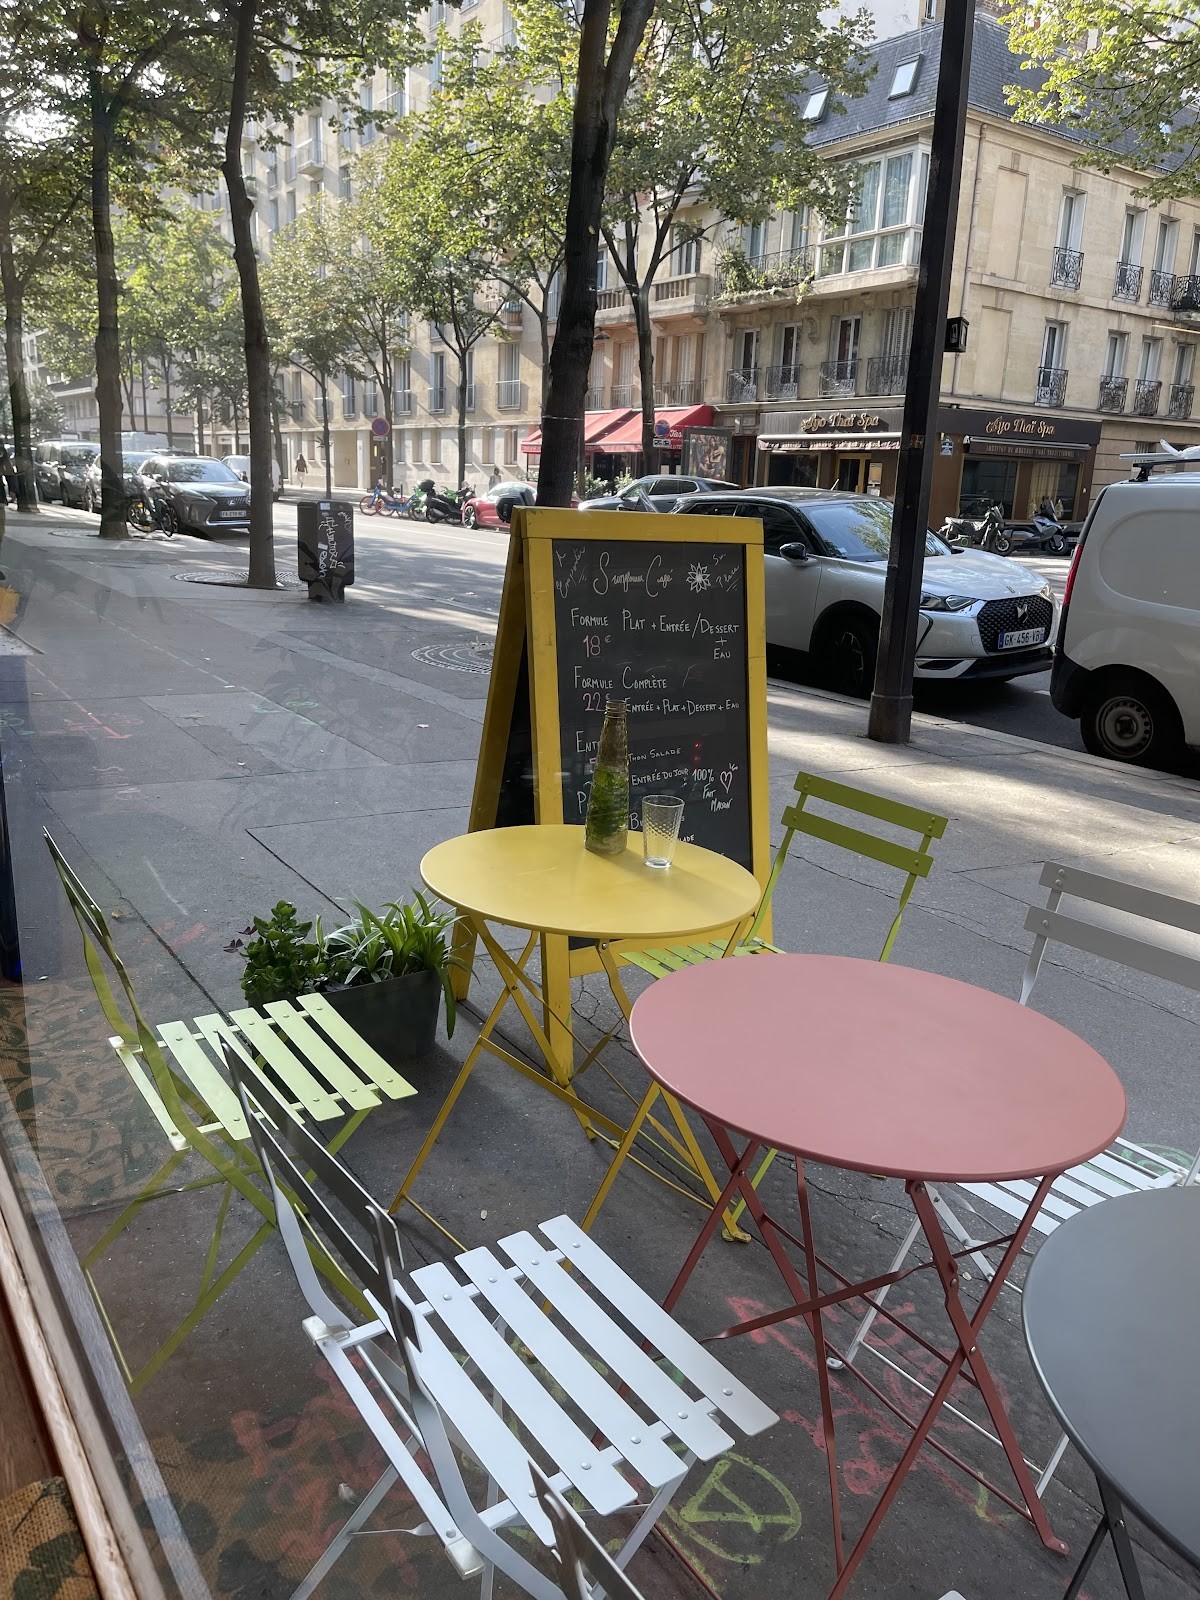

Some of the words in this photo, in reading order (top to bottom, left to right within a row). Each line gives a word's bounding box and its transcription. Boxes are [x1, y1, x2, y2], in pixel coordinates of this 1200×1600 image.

[801, 414, 826, 431] Ayo
[829, 412, 855, 428] Thaï
[857, 413, 880, 430] Spa
[986, 417, 1010, 435] Ayo
[1013, 417, 1035, 434] Thaï
[1037, 421, 1055, 438] Spa
[645, 554, 674, 598] Café
[622, 608, 646, 632] PLAT
[713, 647, 731, 660] EAU
[649, 746, 682, 760] SALADE
[691, 768, 715, 783] 100%
